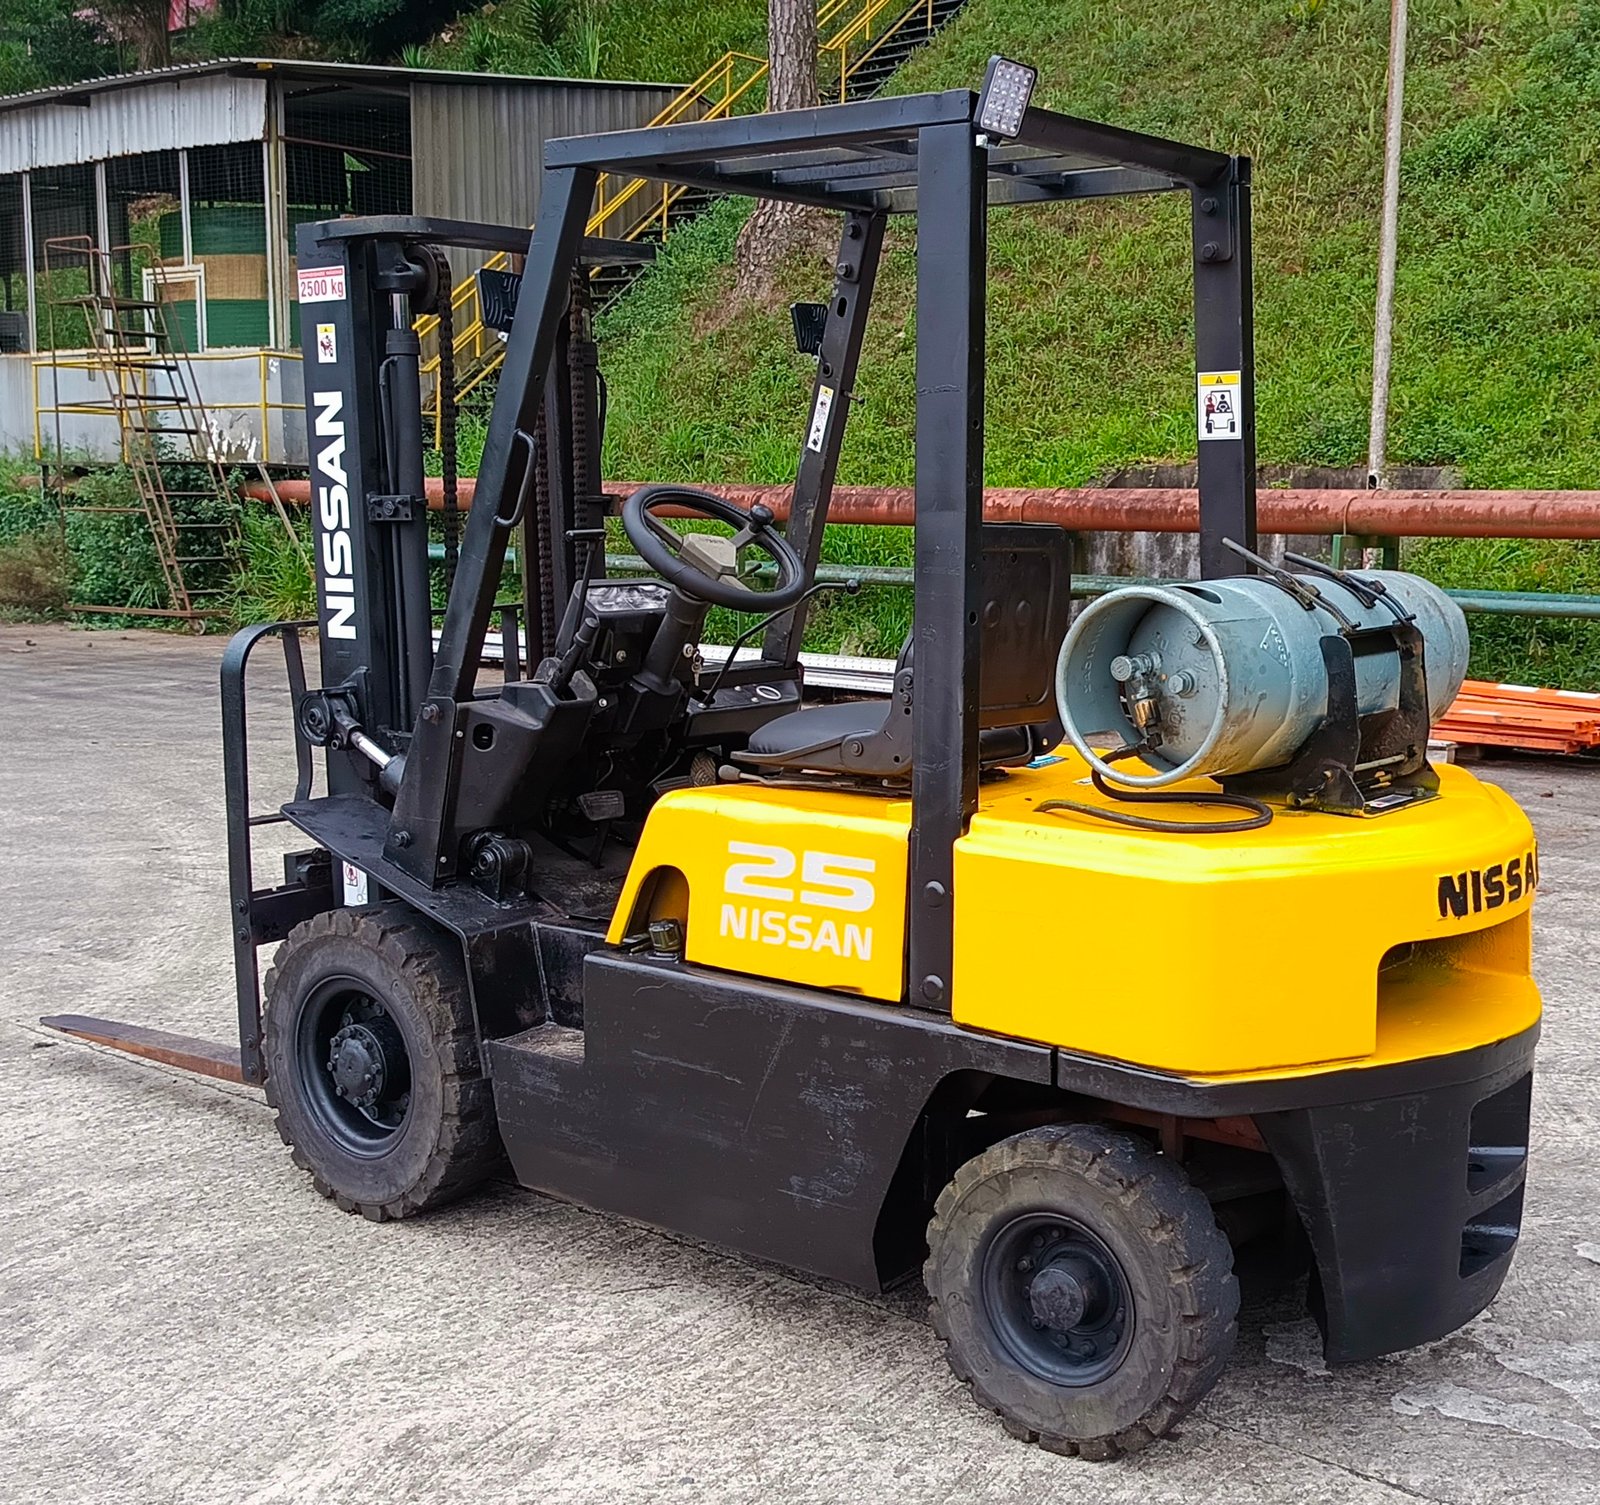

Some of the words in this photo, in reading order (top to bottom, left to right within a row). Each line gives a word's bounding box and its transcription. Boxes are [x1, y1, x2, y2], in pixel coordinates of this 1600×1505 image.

[301, 279, 327, 297] 2500
[331, 278, 344, 298] kg
[313, 391, 357, 640] NISSAN
[724, 840, 876, 913] 25
[1438, 841, 1539, 920] NISSA
[719, 904, 873, 961] NISSAN
